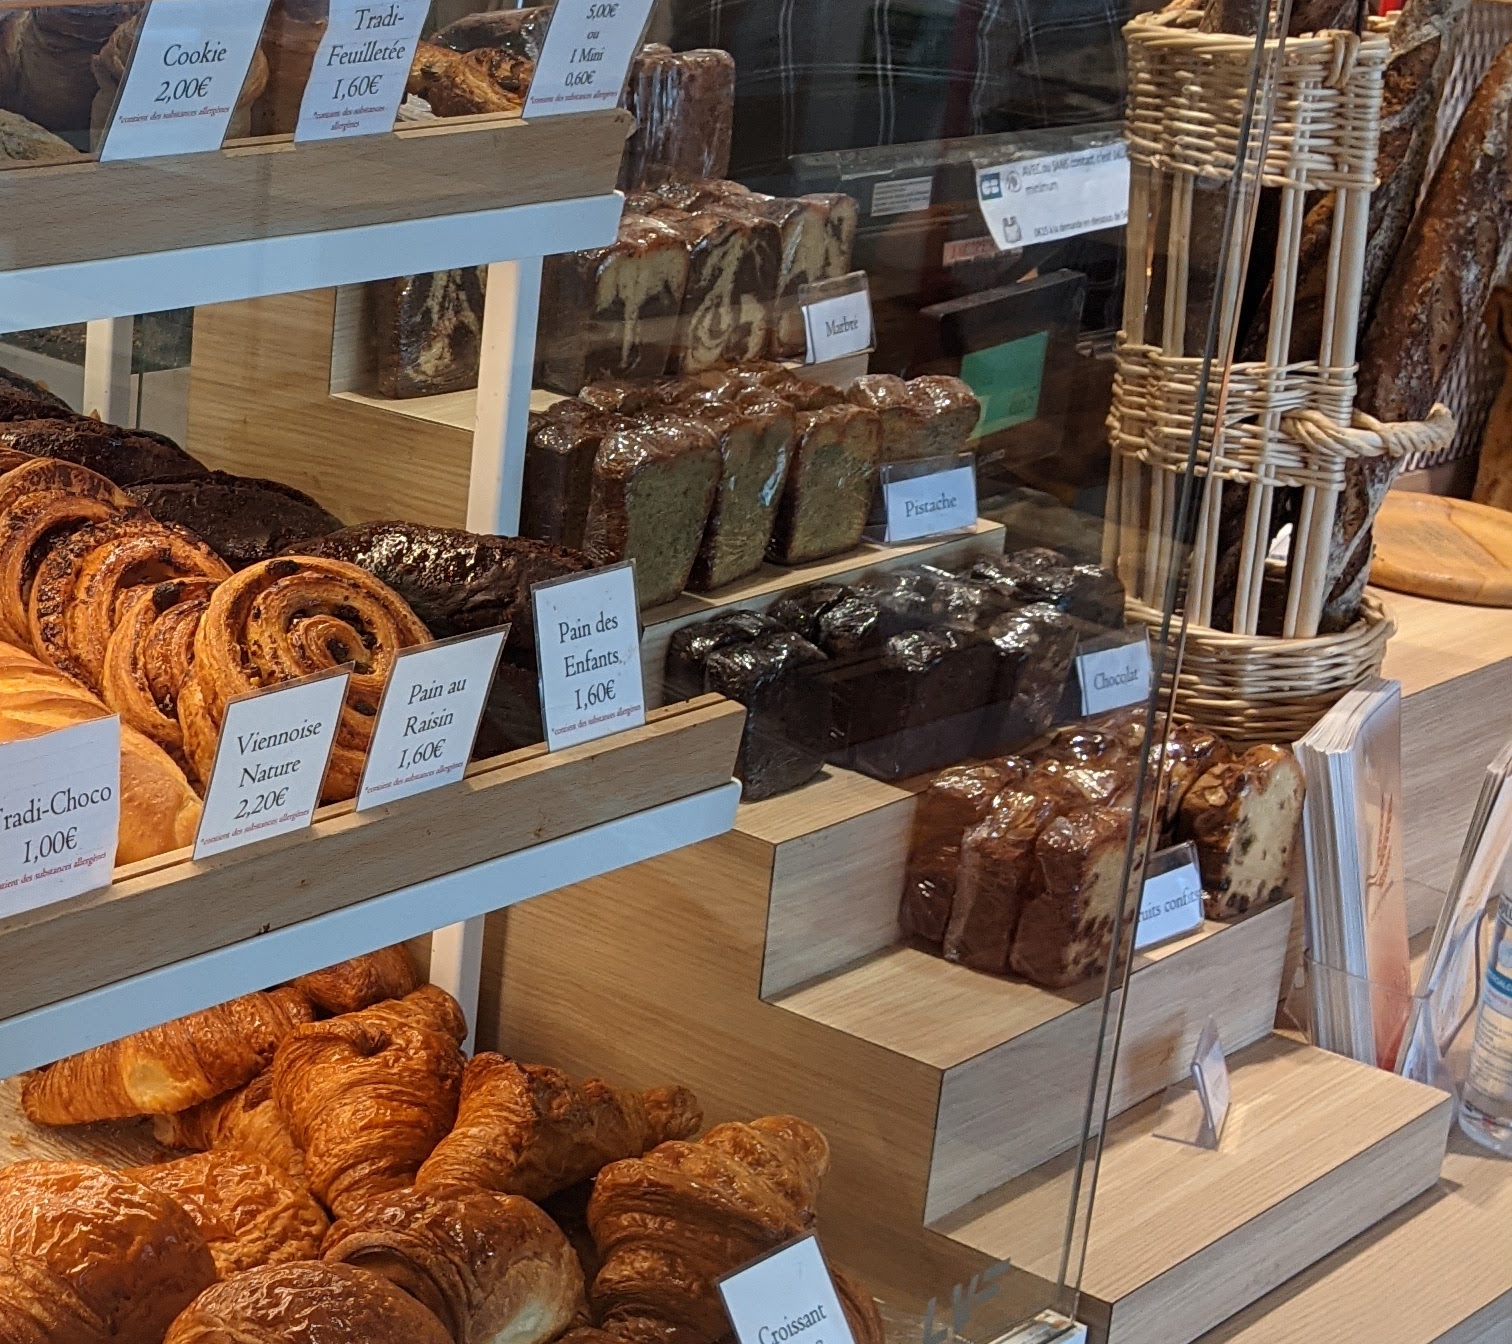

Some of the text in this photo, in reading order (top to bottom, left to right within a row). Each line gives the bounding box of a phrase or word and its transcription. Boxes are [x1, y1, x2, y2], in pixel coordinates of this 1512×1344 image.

[354, 3, 405, 31] Tradi-
[586, 3, 619, 20] 5,00€
[586, 30, 600, 40] ou
[163, 41, 227, 67] Cookie
[326, 39, 406, 67] Feuilletée
[578, 47, 606, 62] Mini
[154, 76, 212, 104] 2,00€
[332, 74, 383, 101] 1,60€
[564, 70, 596, 87] 0,60€
[904, 493, 958, 518] Pistache
[558, 611, 619, 644] Pain des
[407, 677, 467, 706] Pain au
[1093, 666, 1139, 690] Chocolat
[574, 679, 617, 711] 1,60€
[402, 708, 454, 738] Raisin
[235, 719, 323, 756] Viennoise
[397, 738, 447, 770] 1,60€
[238, 757, 302, 789] Nature
[232, 786, 290, 821] 2,20€
[22, 826, 78, 864] 1,00€
[20, 874, 33, 884] des
[35, 866, 72, 880] substances
[1137, 902, 1161, 923] ruits
